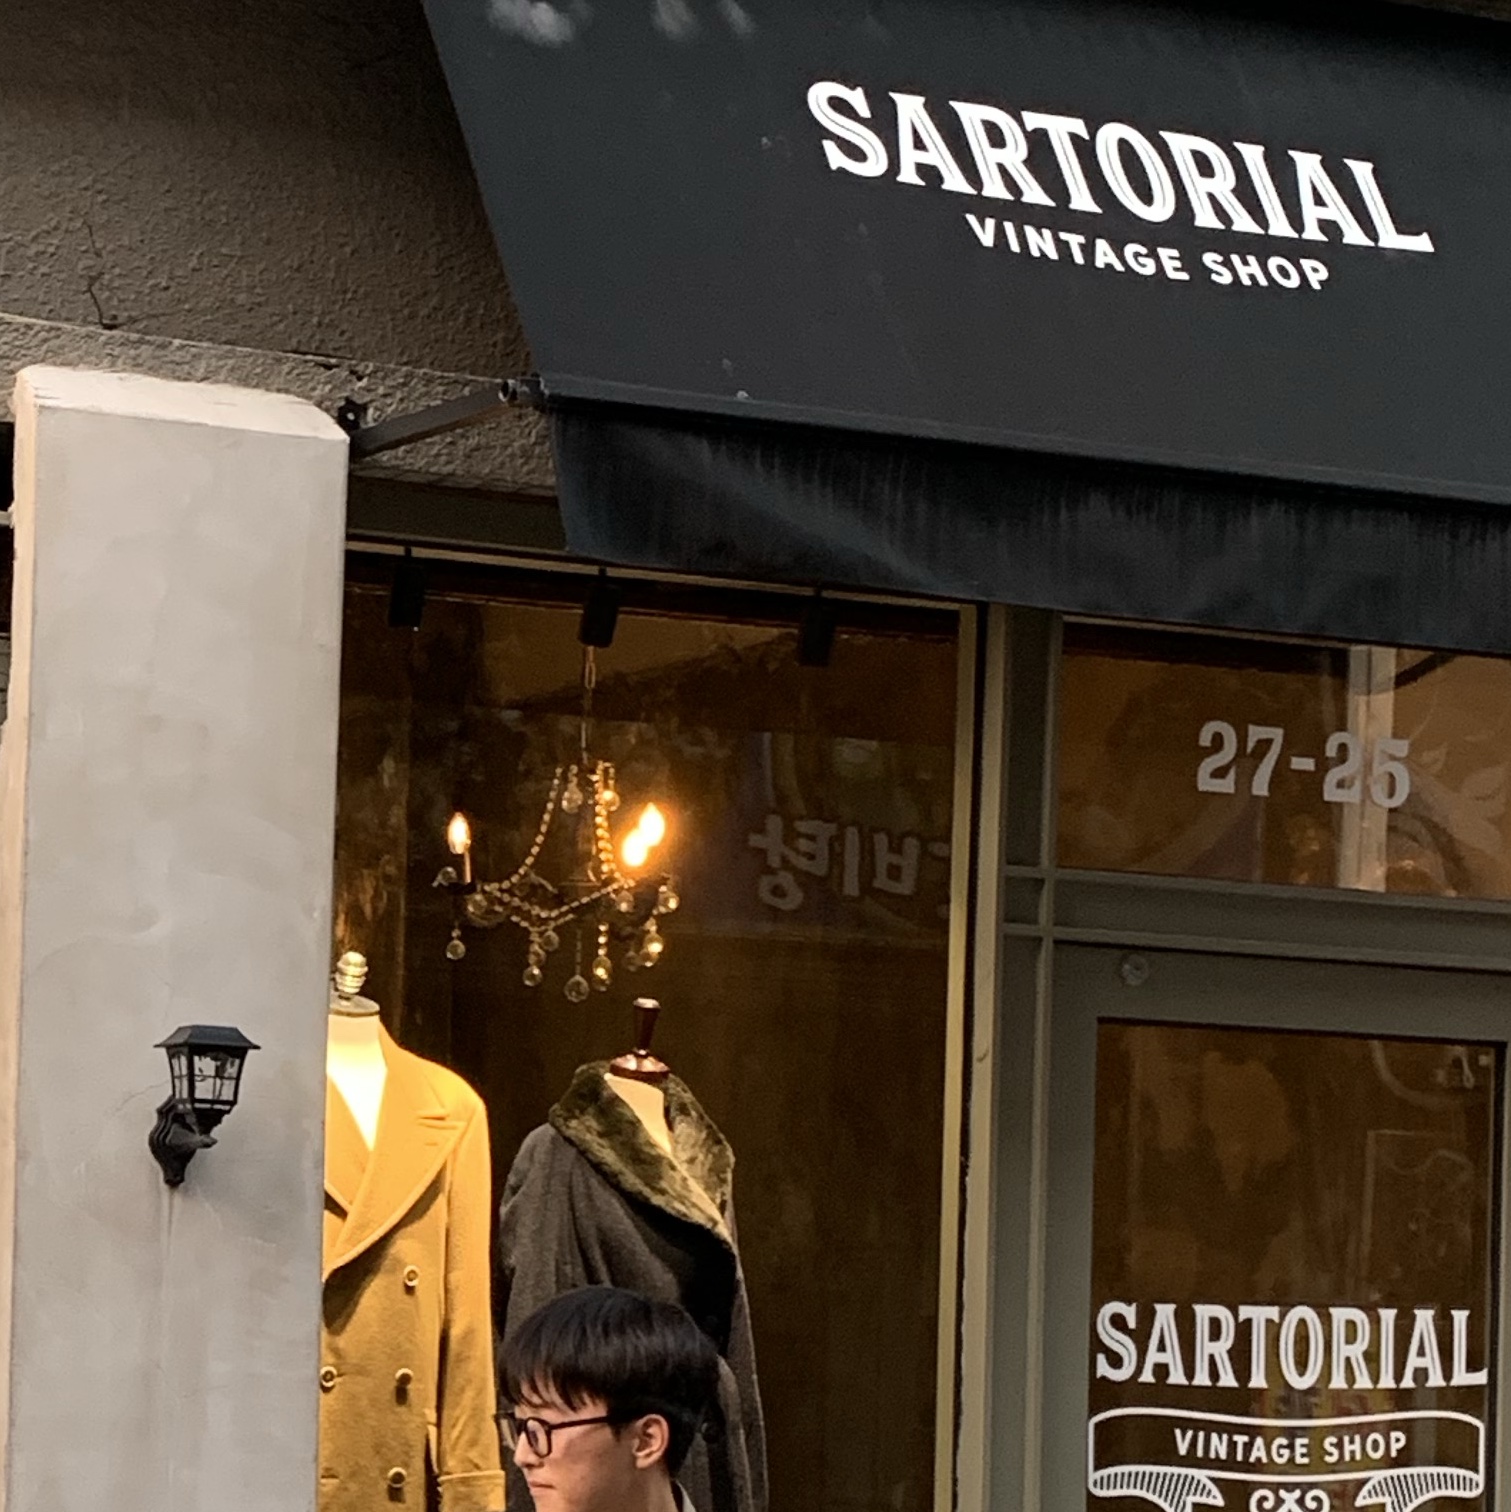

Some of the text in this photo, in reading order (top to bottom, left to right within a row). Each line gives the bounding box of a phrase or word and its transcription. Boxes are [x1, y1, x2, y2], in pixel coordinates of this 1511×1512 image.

[807, 81, 1435, 253] SARTORIAL
[965, 213, 1330, 291] VINTAGE SHOP
[1196, 719, 1412, 809] 27-25
[1095, 1301, 1488, 1390] SARTORIAL
[1173, 1427, 1408, 1465] VINTAGE SHOP
